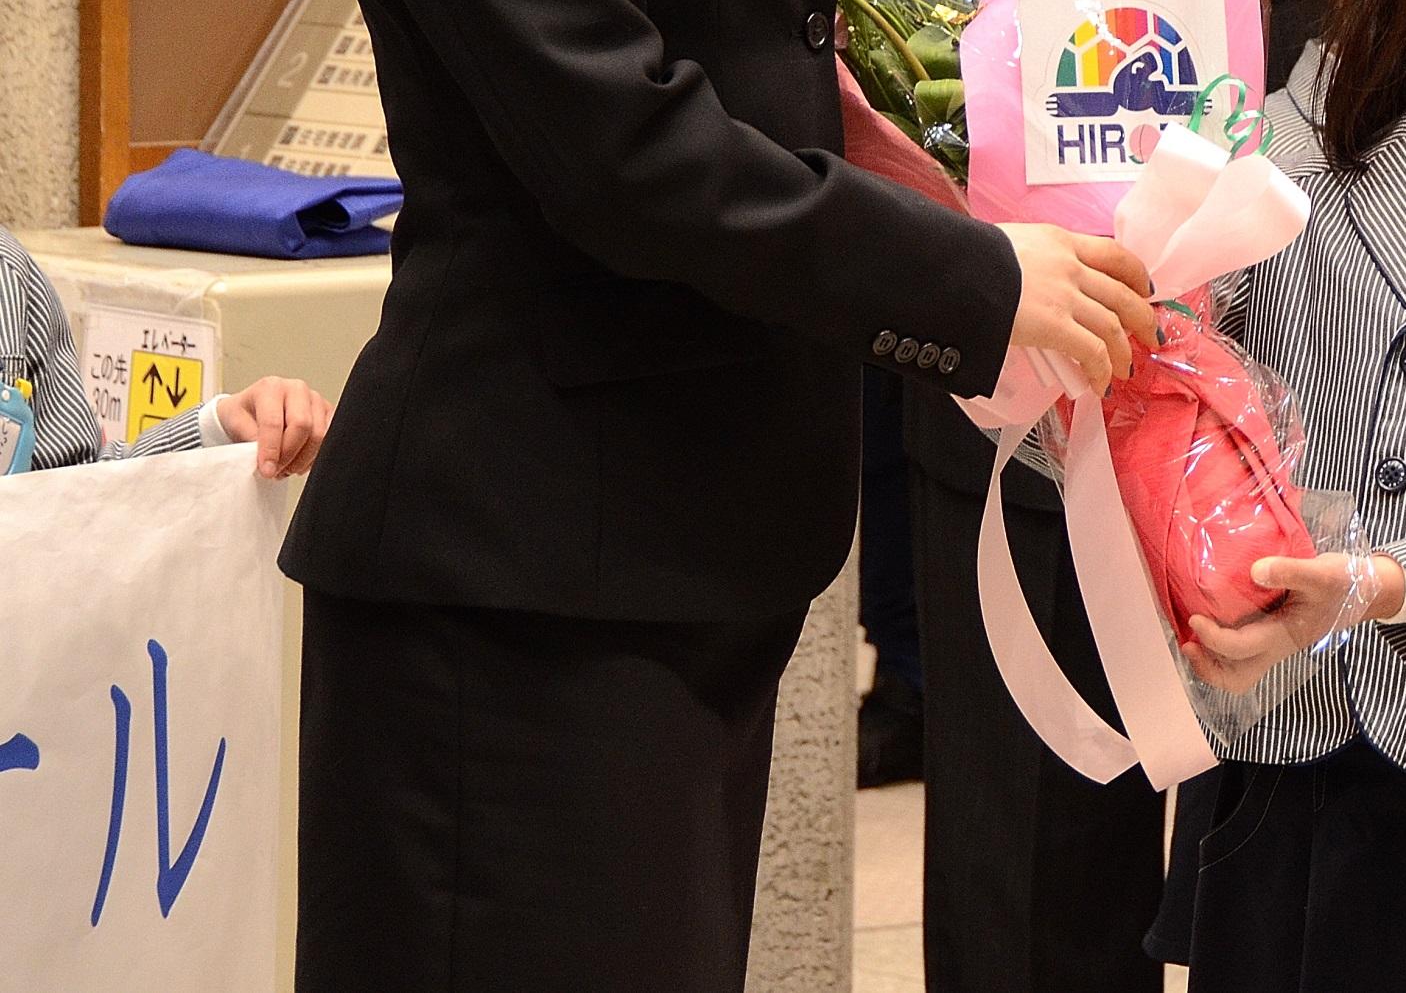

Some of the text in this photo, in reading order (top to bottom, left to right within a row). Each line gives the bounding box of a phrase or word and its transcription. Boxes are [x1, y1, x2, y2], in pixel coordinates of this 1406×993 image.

[1057, 123, 1183, 165] HIRO
[142, 328, 196, 355] エレベーター
[91, 353, 128, 385] この先
[92, 387, 121, 422] 30m
[0, 638, 227, 928] ル
